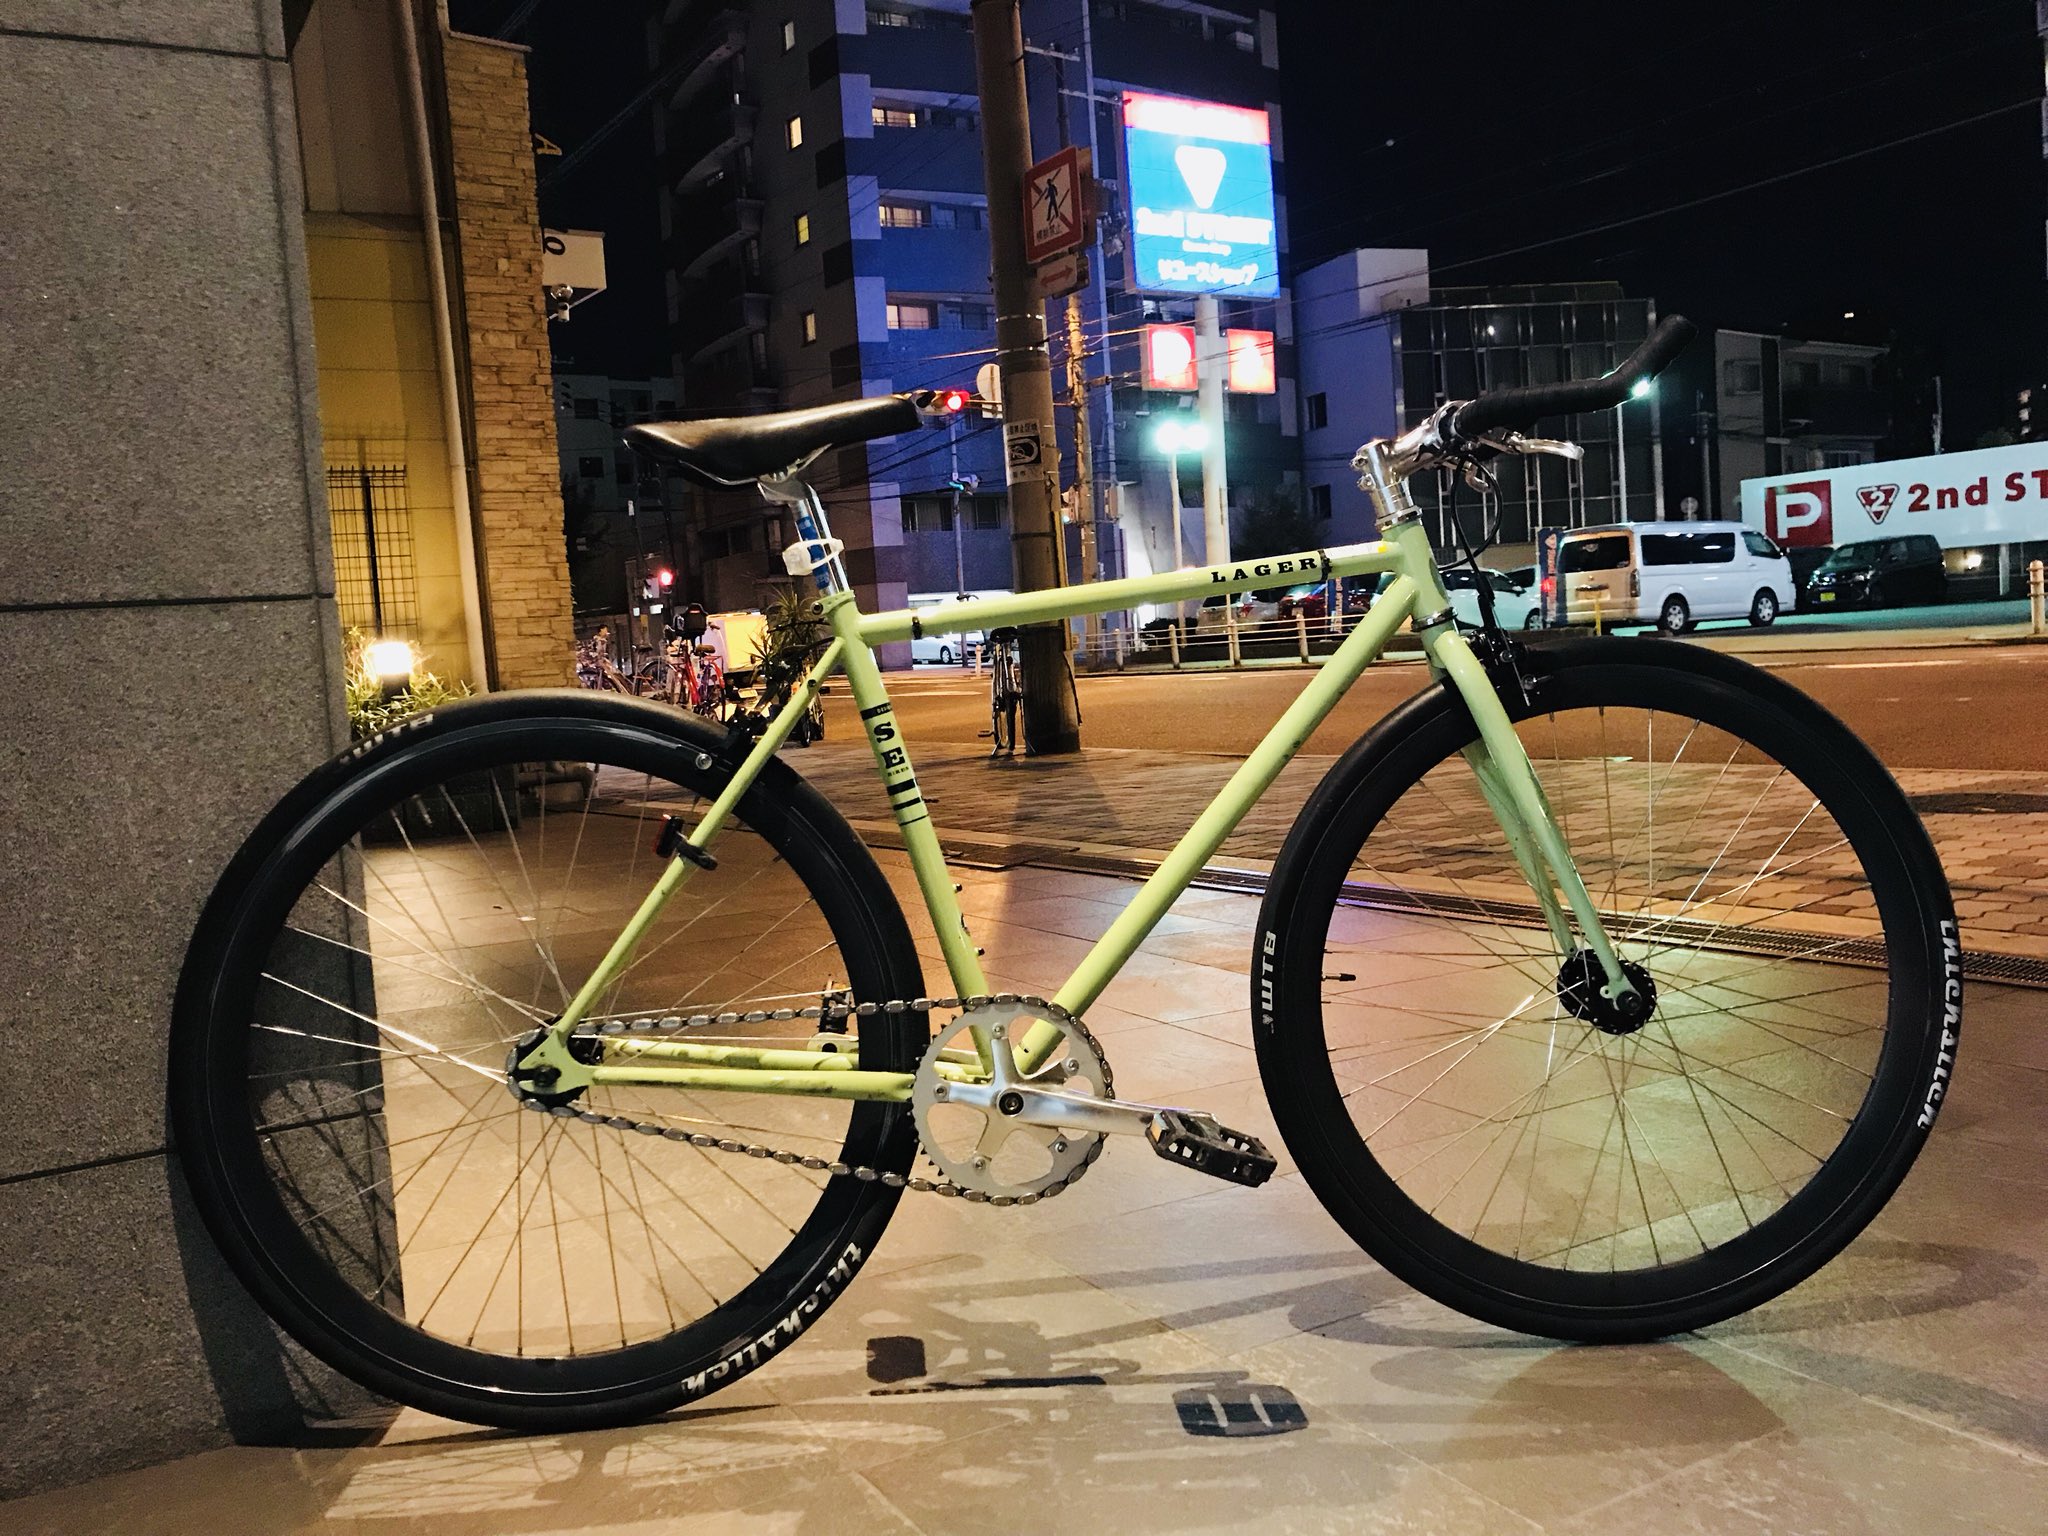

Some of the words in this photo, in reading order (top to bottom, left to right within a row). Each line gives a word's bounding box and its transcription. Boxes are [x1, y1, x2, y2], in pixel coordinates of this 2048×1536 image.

[1908, 476, 1988, 512] 2nd
[2005, 470, 2048, 501] ST
[1776, 491, 1822, 539] P
[1211, 557, 1317, 583] LAGER
[1261, 930, 1276, 1012] WTB
